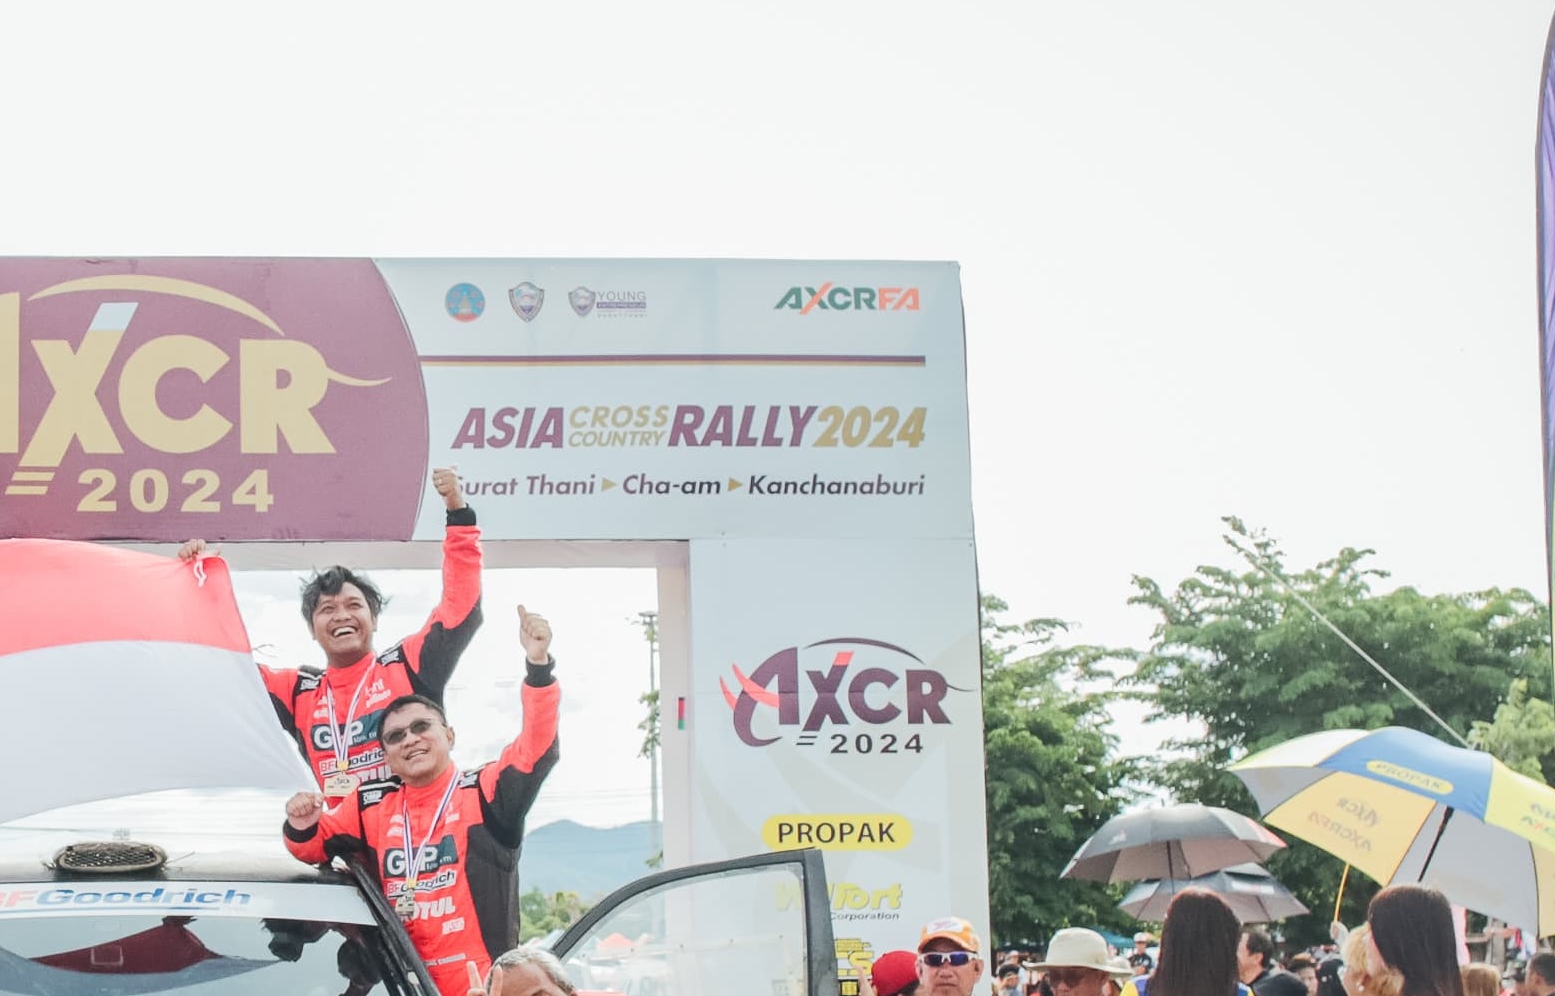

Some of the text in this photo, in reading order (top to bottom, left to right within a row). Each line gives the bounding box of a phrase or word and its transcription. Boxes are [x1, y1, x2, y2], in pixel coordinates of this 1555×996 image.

[597, 291, 647, 301] YOUNG
[773, 281, 920, 315] AXCRFA
[451, 405, 928, 449] ASIA CROSS RALLY 2024
[568, 430, 668, 448] COUNTRY
[76, 468, 275, 513] 2024
[526, 474, 596, 496] Thani
[622, 473, 721, 496] Cha-am
[748, 473, 926, 497] Kanchanaburi
[720, 646, 952, 747] AXCR
[314, 720, 364, 749] GP
[830, 733, 924, 754] 2024
[320, 749, 385, 772] BFoodric
[1375, 763, 1441, 790] PROPAK
[778, 822, 896, 843] PROPAK
[386, 846, 438, 876] GP
[413, 896, 456, 920] OTUL
